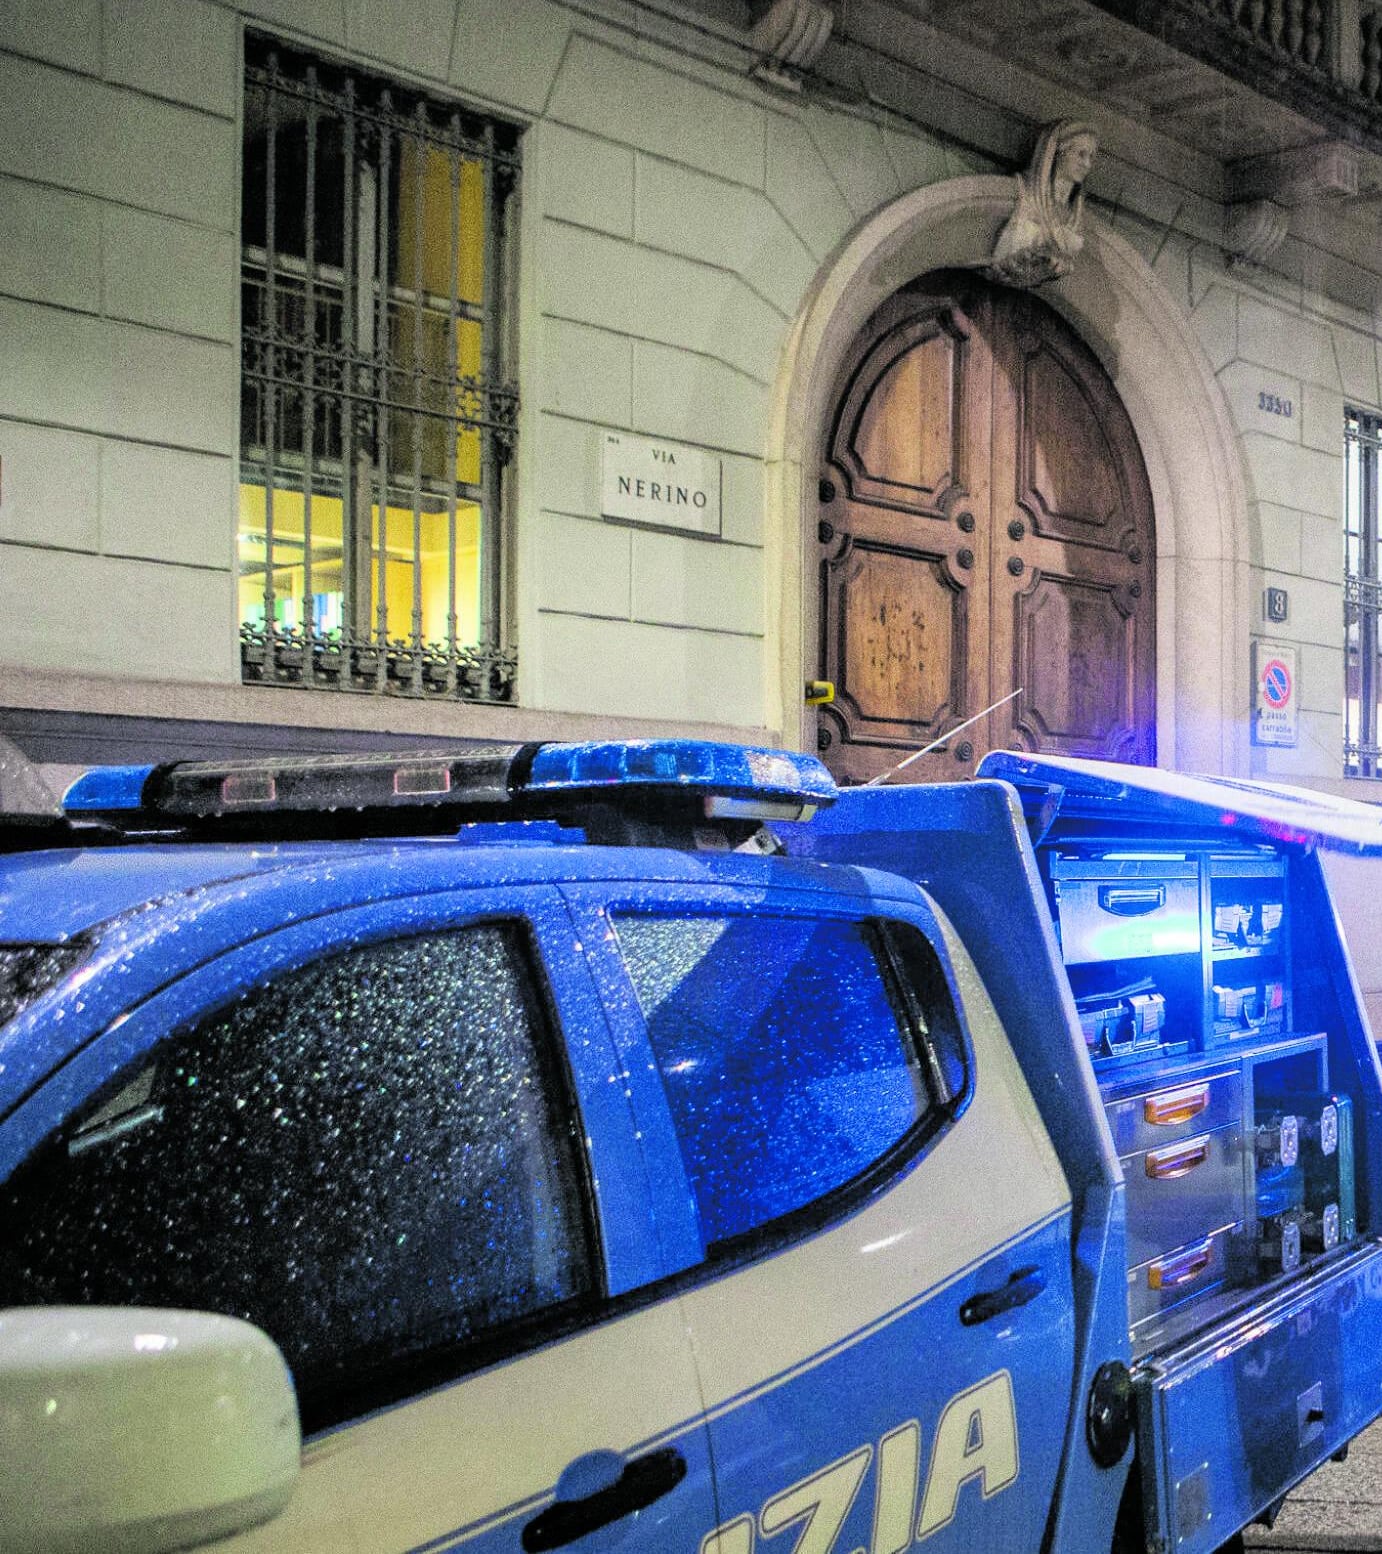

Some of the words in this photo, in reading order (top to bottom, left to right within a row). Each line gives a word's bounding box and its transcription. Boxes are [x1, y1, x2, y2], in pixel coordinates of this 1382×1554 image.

[652, 448, 676, 465] VIA
[618, 475, 707, 508] NERINO
[1274, 591, 1284, 614] 8
